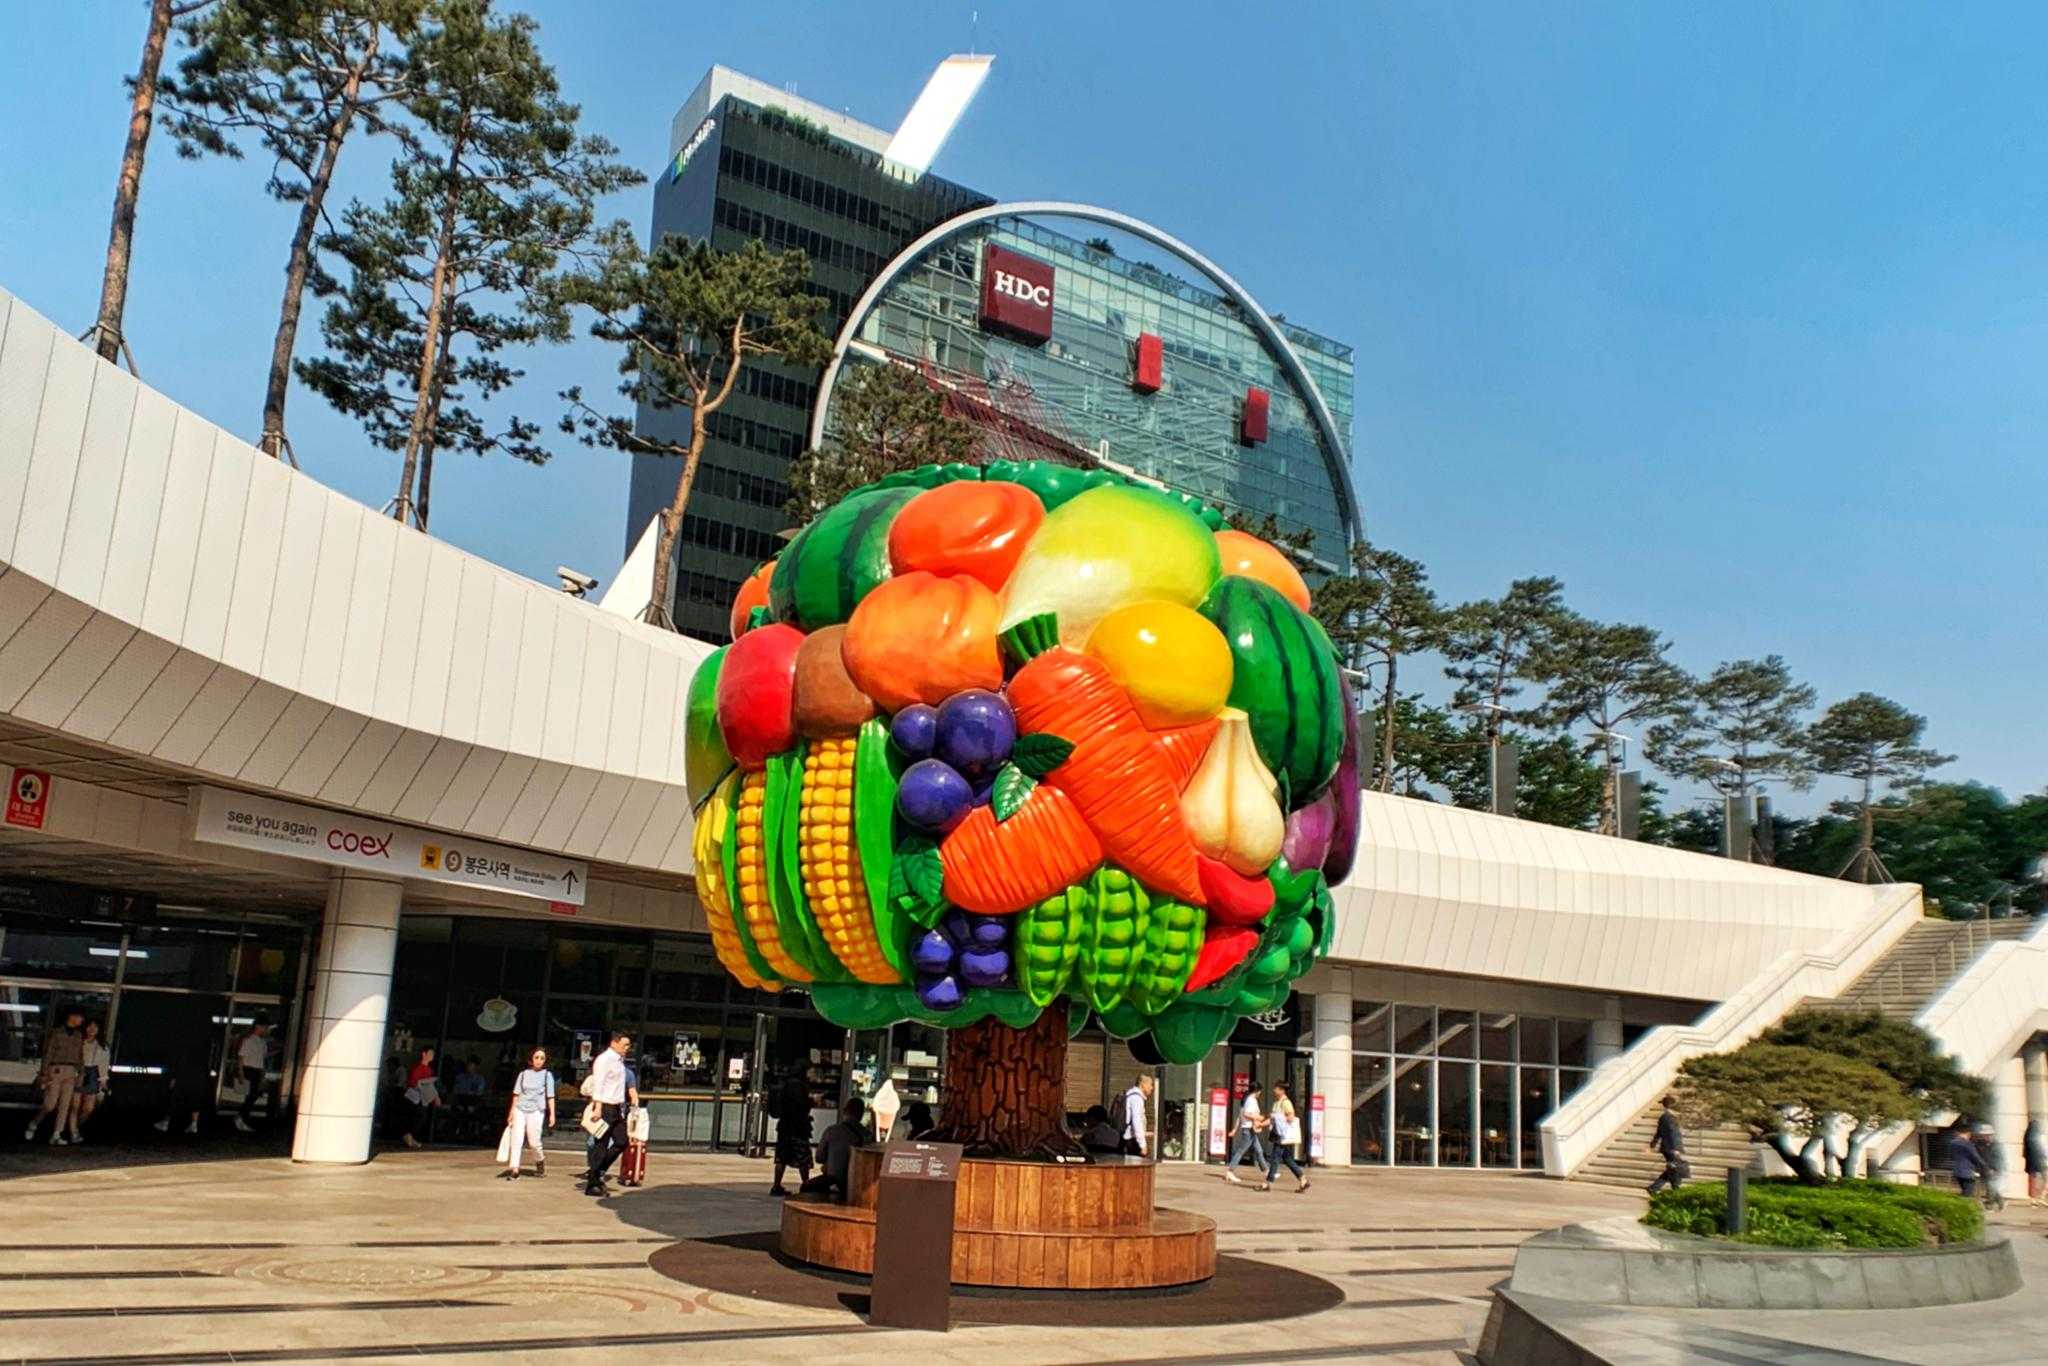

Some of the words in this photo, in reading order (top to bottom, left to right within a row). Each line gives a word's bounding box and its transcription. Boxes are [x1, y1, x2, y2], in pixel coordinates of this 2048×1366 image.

[994, 269, 1050, 307] HDC
[227, 810, 253, 825] see
[255, 815, 280, 830] you
[281, 821, 318, 837] again
[465, 857, 510, 880] 봉은사역
